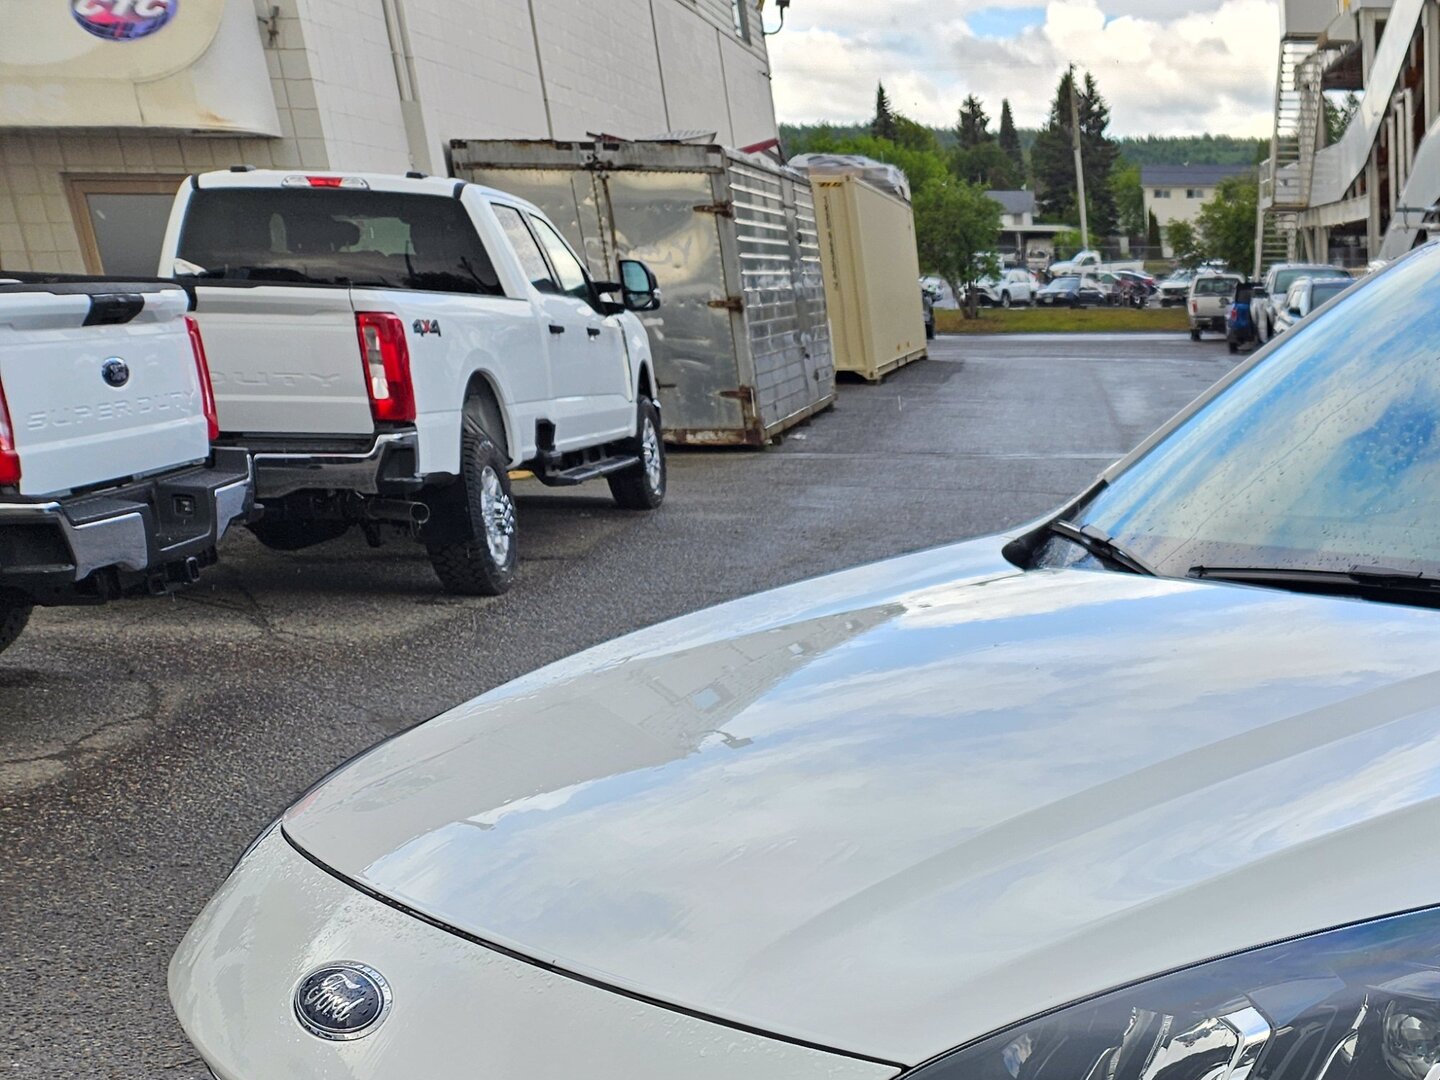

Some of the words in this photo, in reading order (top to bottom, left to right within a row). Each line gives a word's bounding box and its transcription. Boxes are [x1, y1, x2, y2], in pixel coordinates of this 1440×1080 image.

[27, 399, 133, 431] SUPER
[136, 389, 195, 416] DUTY
[304, 973, 362, 1022] Ford
